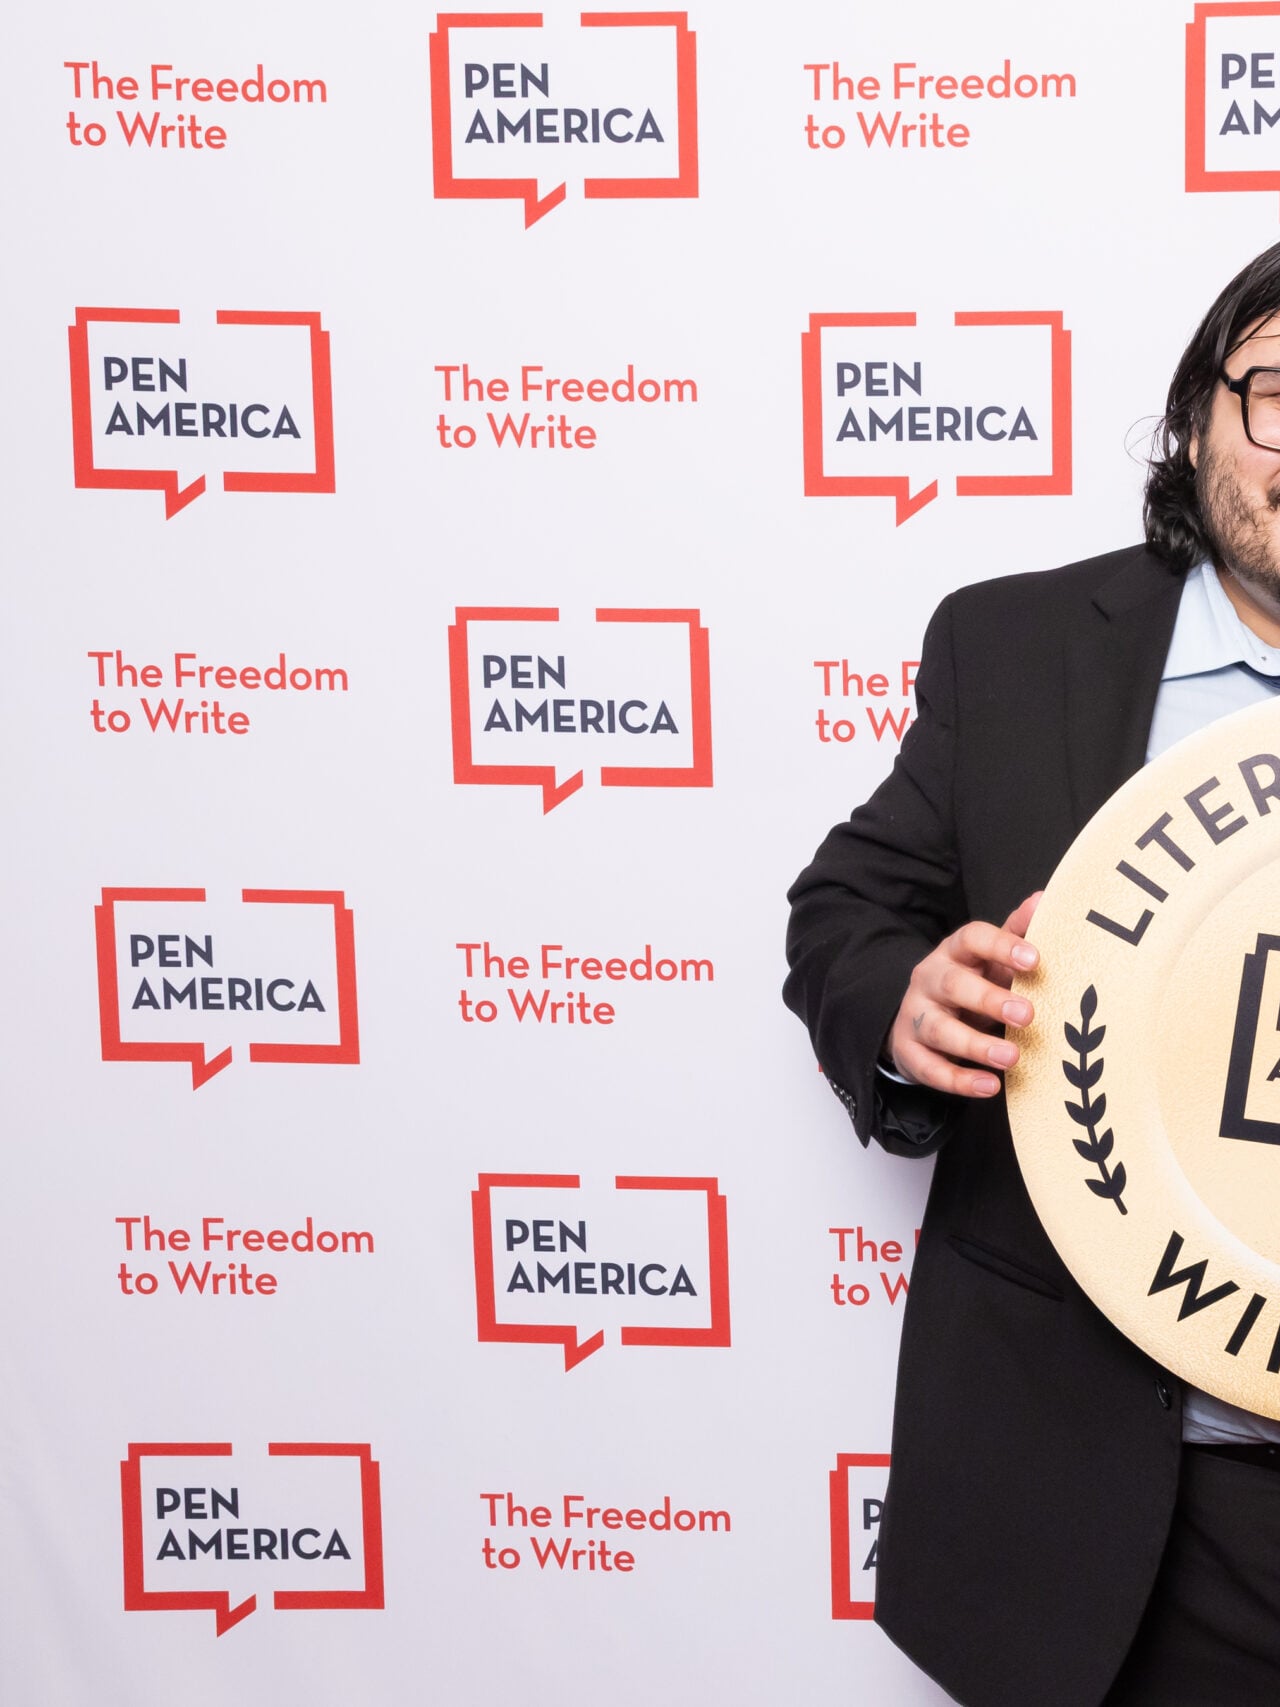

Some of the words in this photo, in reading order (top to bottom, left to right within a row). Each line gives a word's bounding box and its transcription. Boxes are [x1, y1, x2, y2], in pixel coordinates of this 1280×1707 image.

[63, 60, 139, 101] The
[150, 63, 328, 104] Freedom
[465, 63, 549, 98] PEN
[803, 61, 881, 101] The
[893, 59, 1076, 100] Freedom
[65, 111, 107, 147] to
[116, 110, 228, 150] Write
[465, 108, 664, 143] AMERICA
[804, 114, 846, 150] to
[857, 111, 971, 148] Write
[103, 356, 187, 392] PEN
[434, 363, 510, 402] The
[521, 364, 698, 403] Freedom
[837, 362, 921, 397] PEN
[105, 402, 301, 439] AMERICA
[436, 414, 477, 449] to
[486, 412, 597, 449] Write
[836, 406, 1038, 442] AMERICA
[87, 649, 164, 689] The
[174, 652, 349, 692] Freedom
[483, 655, 566, 689] PEN
[813, 658, 890, 697] The
[89, 698, 131, 733] to
[140, 697, 250, 735] Write
[484, 699, 679, 734] AMERICA
[815, 708, 856, 743] to
[130, 934, 213, 968] PEN
[455, 941, 530, 979] The
[540, 944, 715, 982] Freedom
[132, 977, 326, 1012] AMERICA
[458, 989, 498, 1023] to
[507, 988, 616, 1025] Write
[114, 1215, 191, 1252] The
[201, 1216, 375, 1254] Freedom
[505, 1219, 587, 1253] PEN
[828, 1225, 903, 1263] The
[117, 1262, 159, 1296] to
[167, 1260, 278, 1296] Write
[507, 1261, 698, 1297] AMERICA
[830, 1273, 871, 1307] to
[156, 1487, 239, 1520] PEN
[479, 1491, 552, 1528] The
[562, 1494, 732, 1533] Freedom
[156, 1527, 352, 1561] AMERICA
[481, 1537, 521, 1570] to
[529, 1536, 636, 1573] Write
